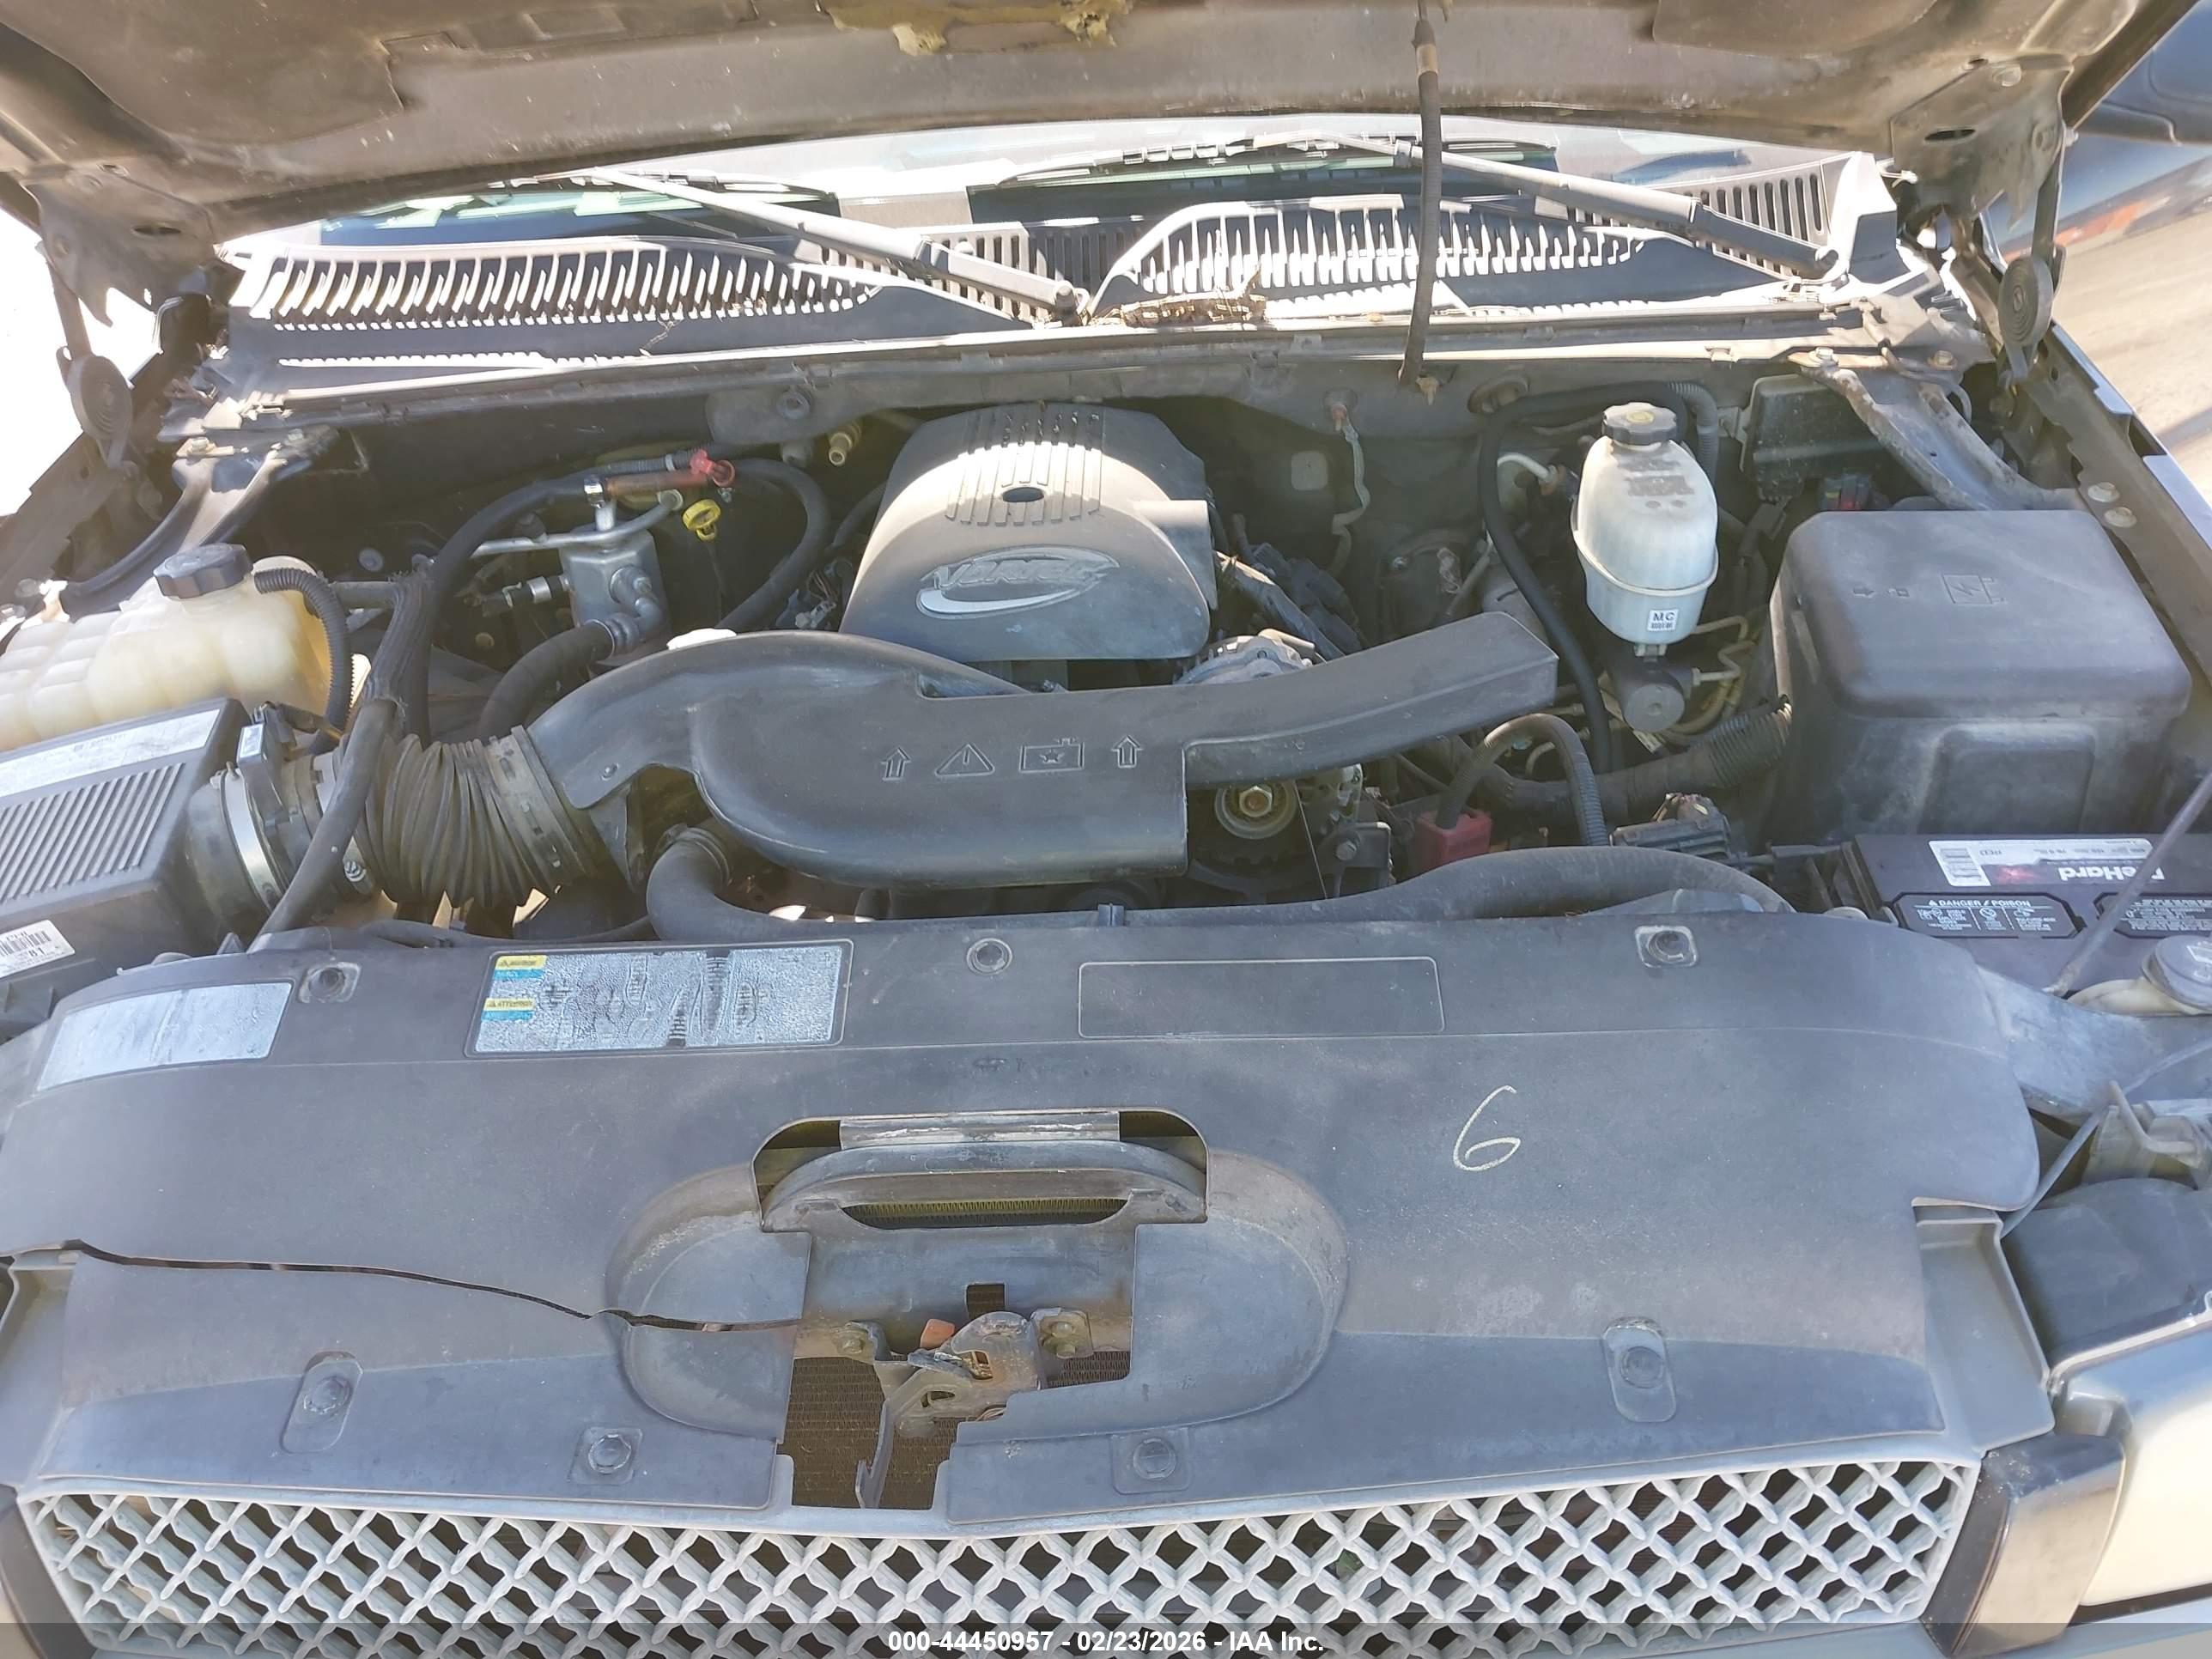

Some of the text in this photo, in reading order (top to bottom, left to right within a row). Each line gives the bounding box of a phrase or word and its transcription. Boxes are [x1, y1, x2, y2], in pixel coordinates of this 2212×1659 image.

[2058, 866, 2165, 881] eHard
[1938, 899, 1982, 908] DANGER
[1991, 899, 2033, 908] POISON
[1453, 1085, 1521, 1171] 6
